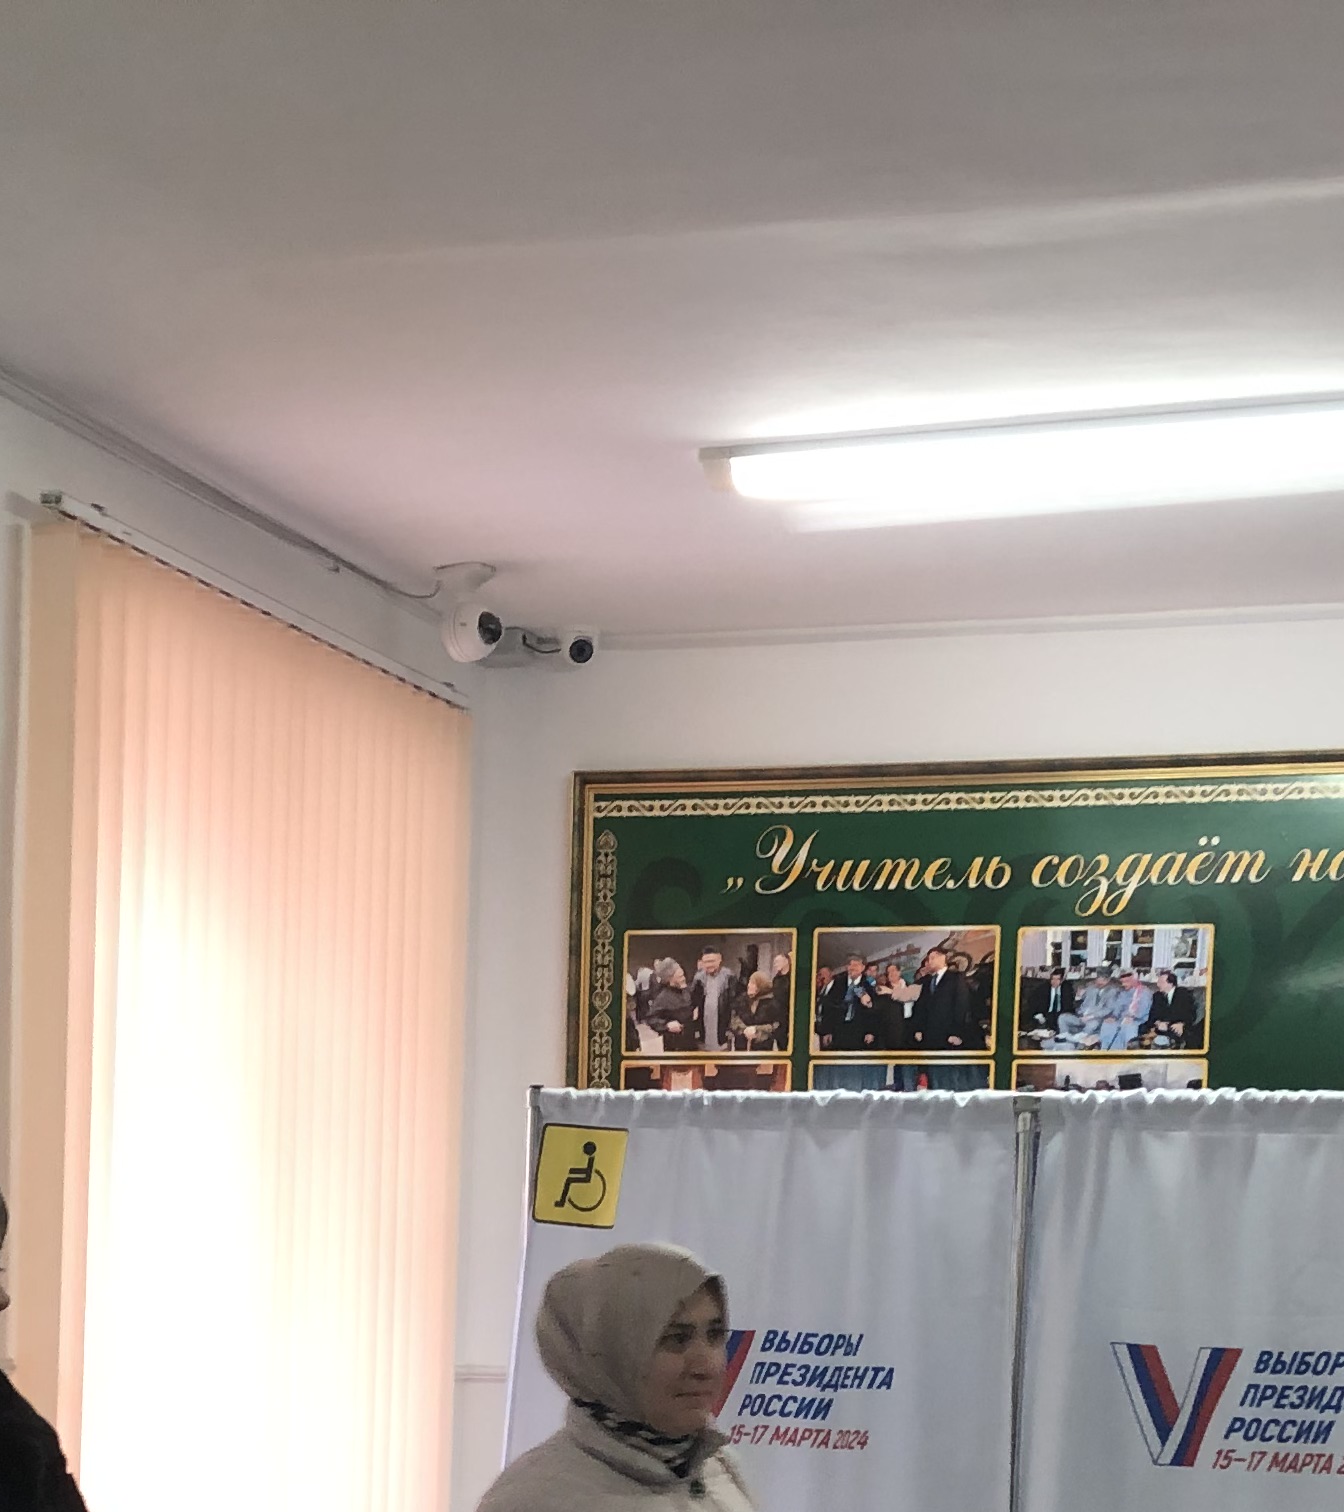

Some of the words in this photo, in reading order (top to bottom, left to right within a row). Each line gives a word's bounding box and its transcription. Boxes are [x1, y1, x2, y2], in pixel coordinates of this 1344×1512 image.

[1030, 835, 1271, 918] создаёт
[760, 1329, 864, 1357] ВЫБОРЫ
[750, 1362, 895, 1392] ПРЕЗИДЕНТА
[738, 1393, 834, 1421] РОССИИ
[769, 1426, 832, 1449] МАРТА
[832, 1429, 869, 1450] 2024
[1223, 1417, 1336, 1444] РОССИИ
[1267, 1451, 1333, 1475] МАРТА
